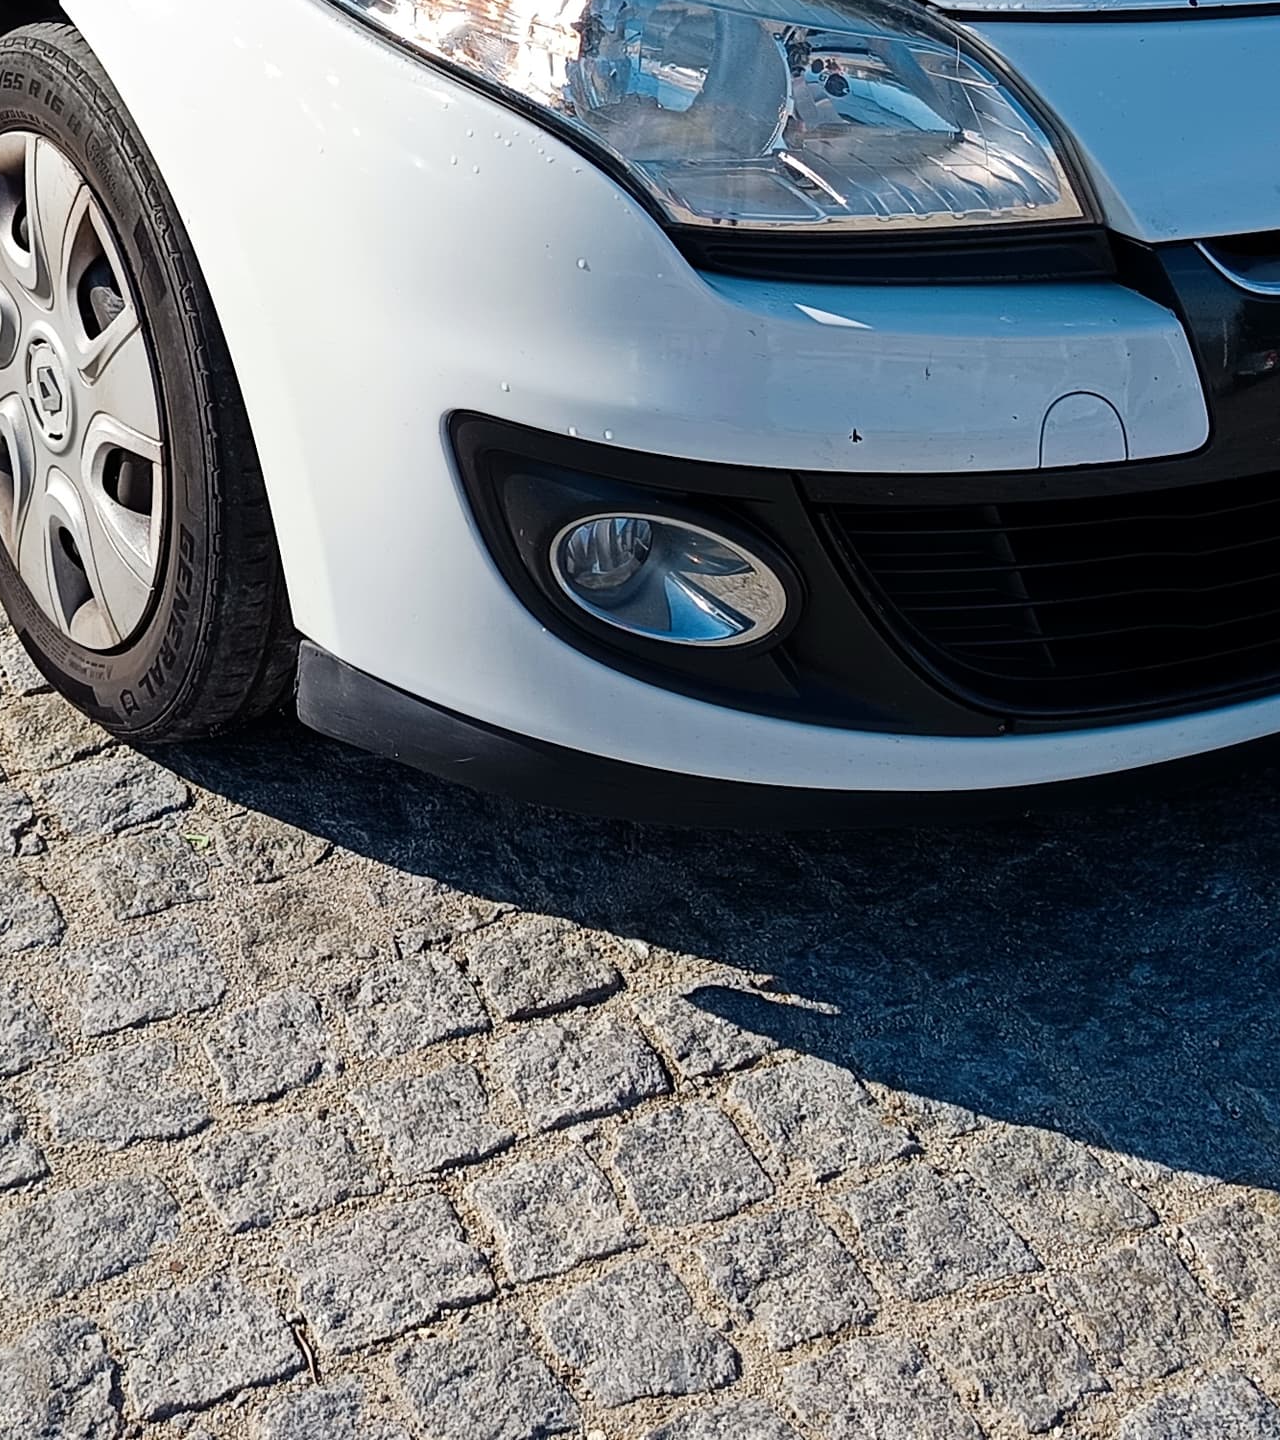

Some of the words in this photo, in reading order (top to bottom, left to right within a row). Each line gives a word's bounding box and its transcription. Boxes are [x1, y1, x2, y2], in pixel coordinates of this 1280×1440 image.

[28, 78, 42, 99] R
[44, 88, 65, 113] 16
[138, 522, 195, 700] GENERAL
